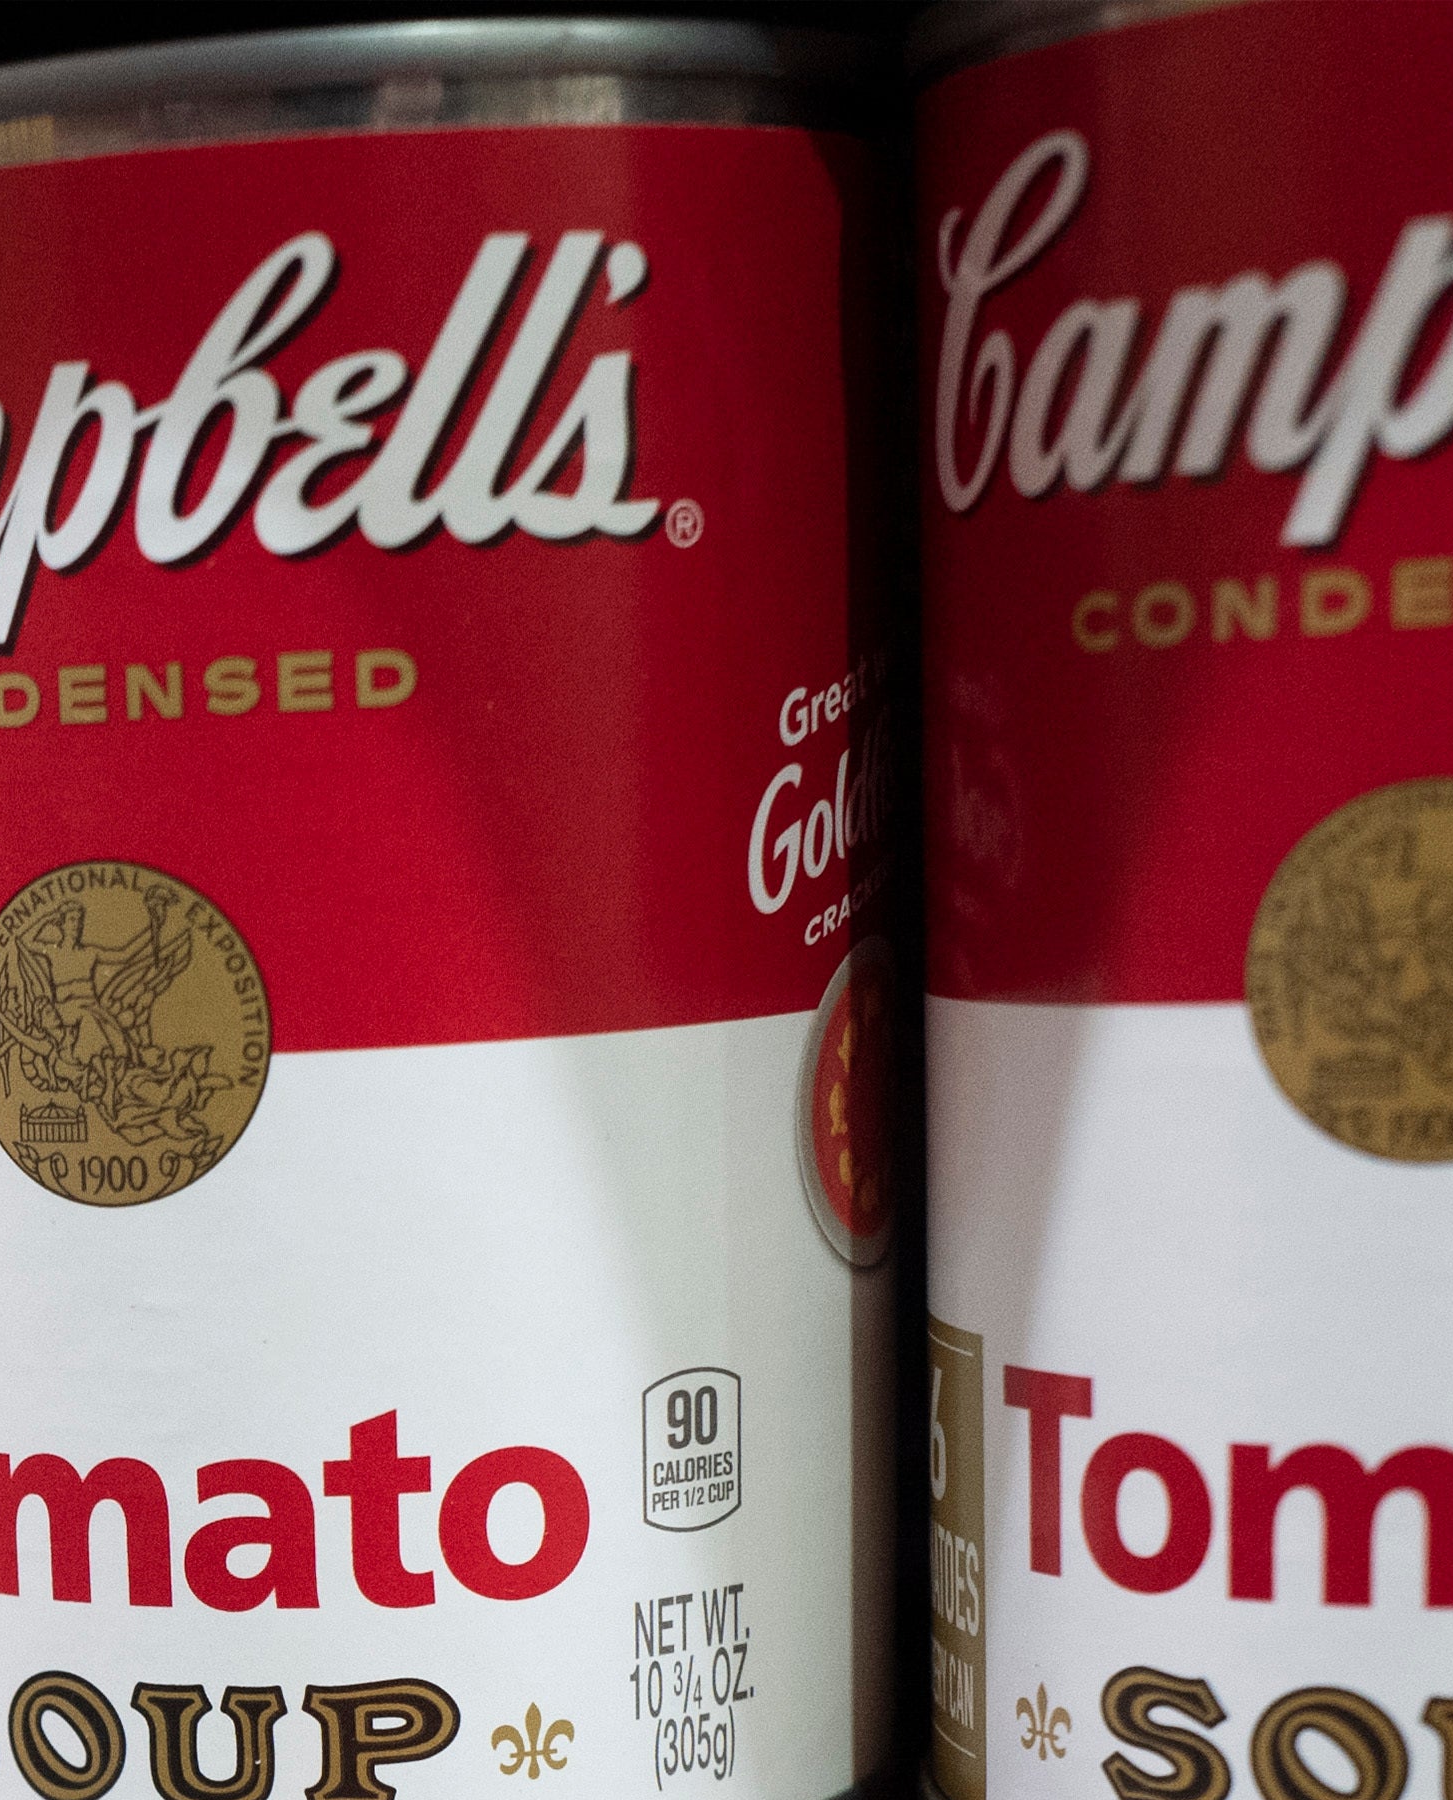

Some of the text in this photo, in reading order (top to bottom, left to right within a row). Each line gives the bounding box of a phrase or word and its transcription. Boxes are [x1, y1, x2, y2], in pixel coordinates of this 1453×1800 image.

[183, 900, 264, 1088] EXPOSITION
[78, 1155, 148, 1196] 1900
[666, 1385, 719, 1450] 90
[651, 1480, 735, 1513] PER 1/2 CUP
[652, 1451, 735, 1488] CALORIES
[633, 1582, 751, 1660] NET WT.
[629, 1660, 663, 1721] 10
[711, 1642, 755, 1707] OZ.
[654, 1704, 736, 1792] (305g)
